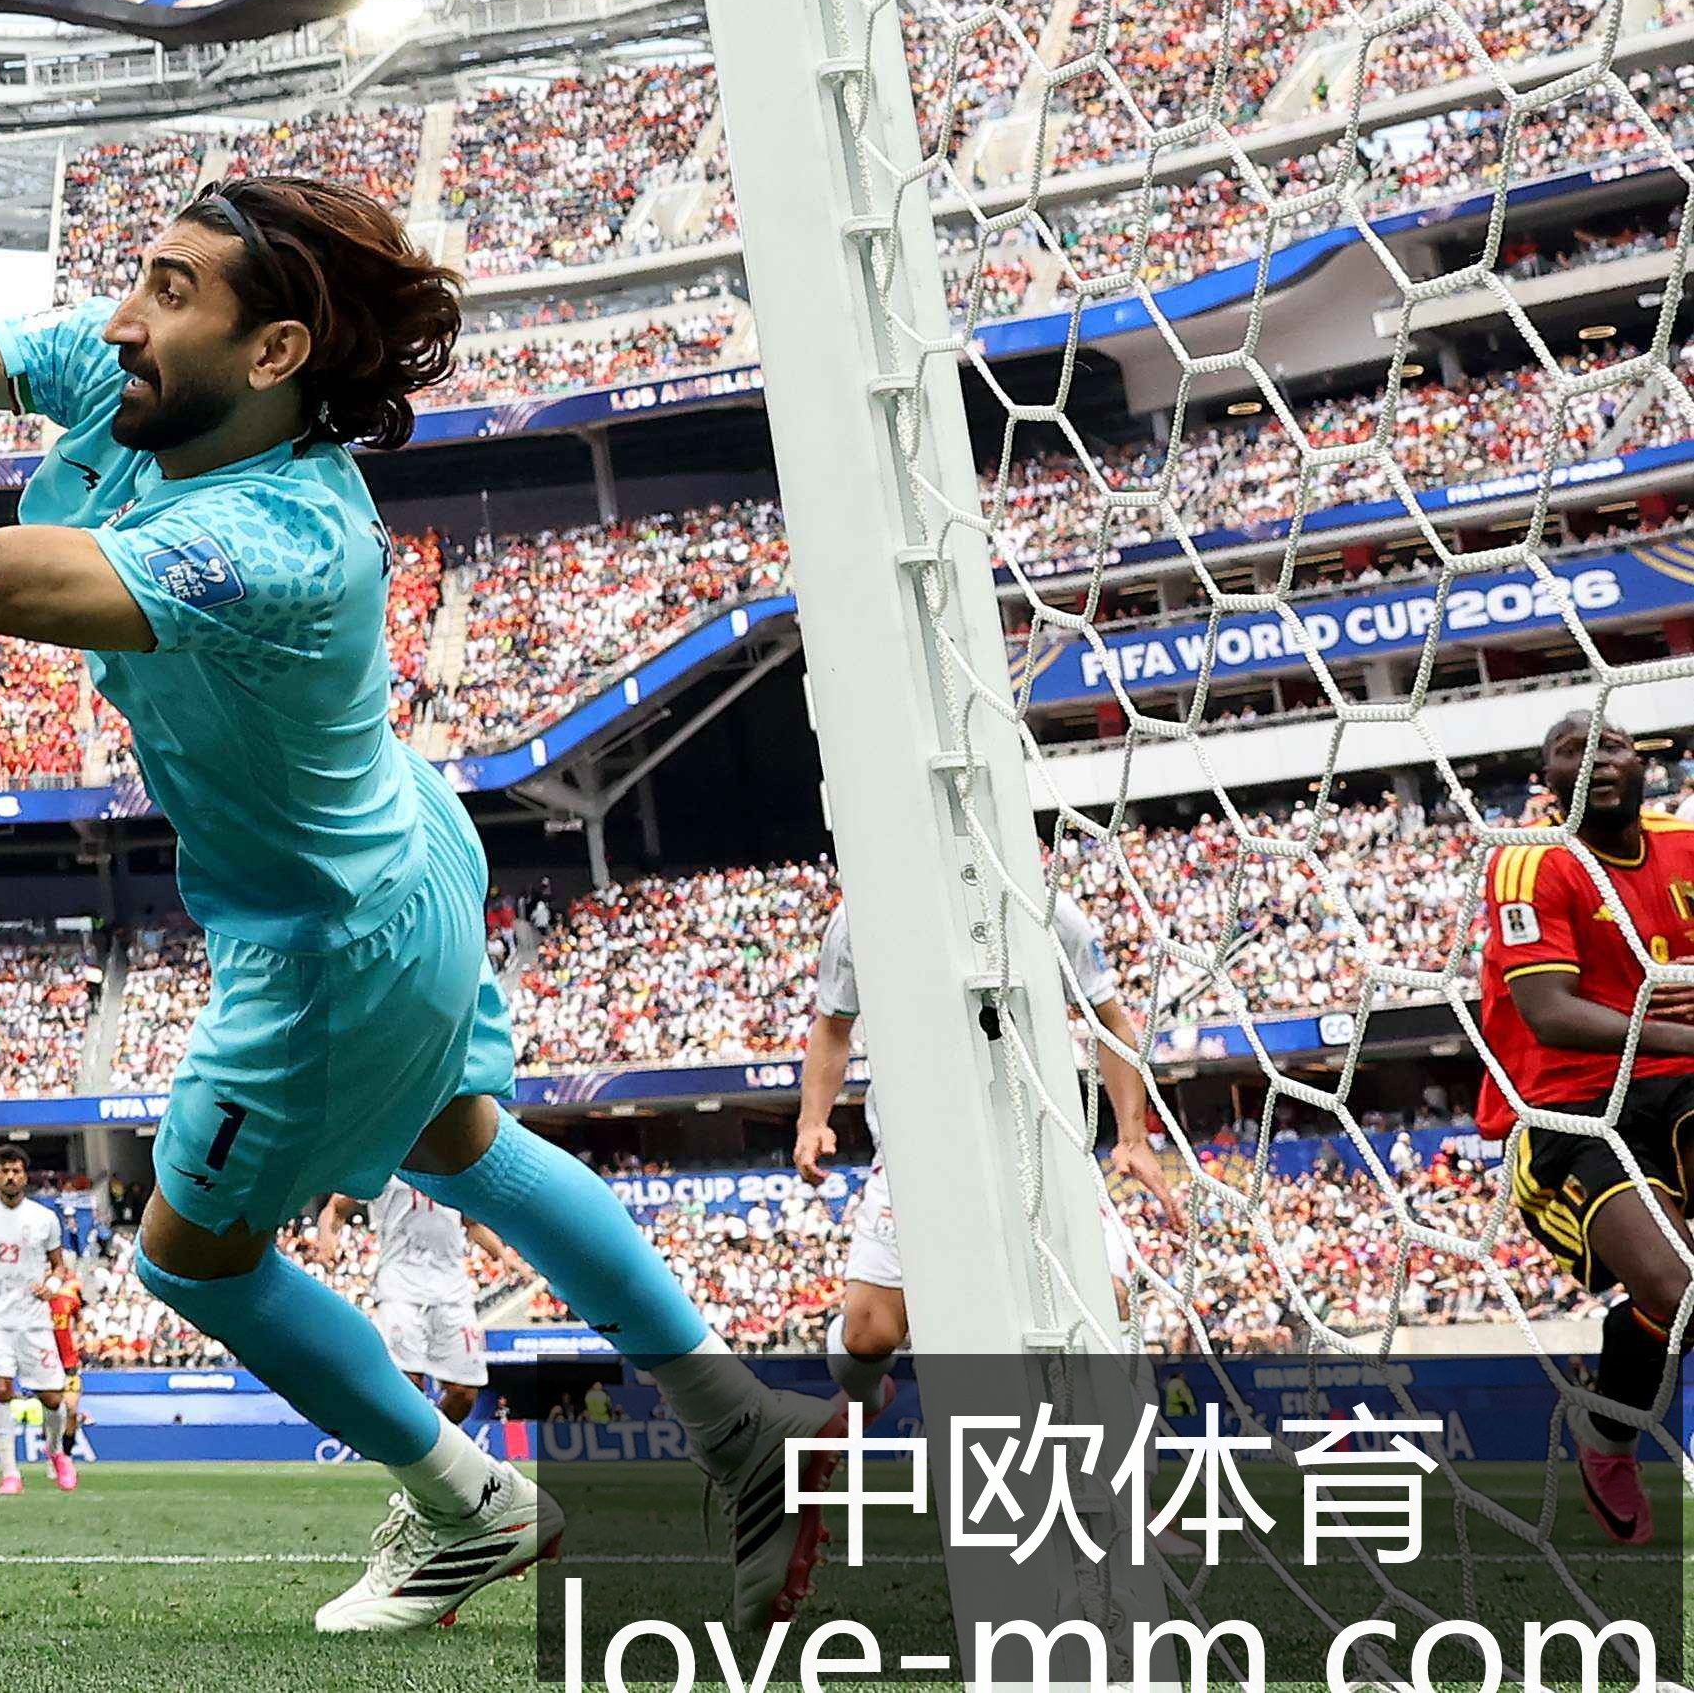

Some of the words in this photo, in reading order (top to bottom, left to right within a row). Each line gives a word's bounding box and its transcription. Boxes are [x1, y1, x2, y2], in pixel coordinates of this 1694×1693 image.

[1081, 642, 1177, 688] FIFA
[1176, 612, 1340, 672] WORLD
[1344, 597, 1439, 645] CUP
[205, 1101, 247, 1172] 1
[673, 1176, 735, 1205] CUP
